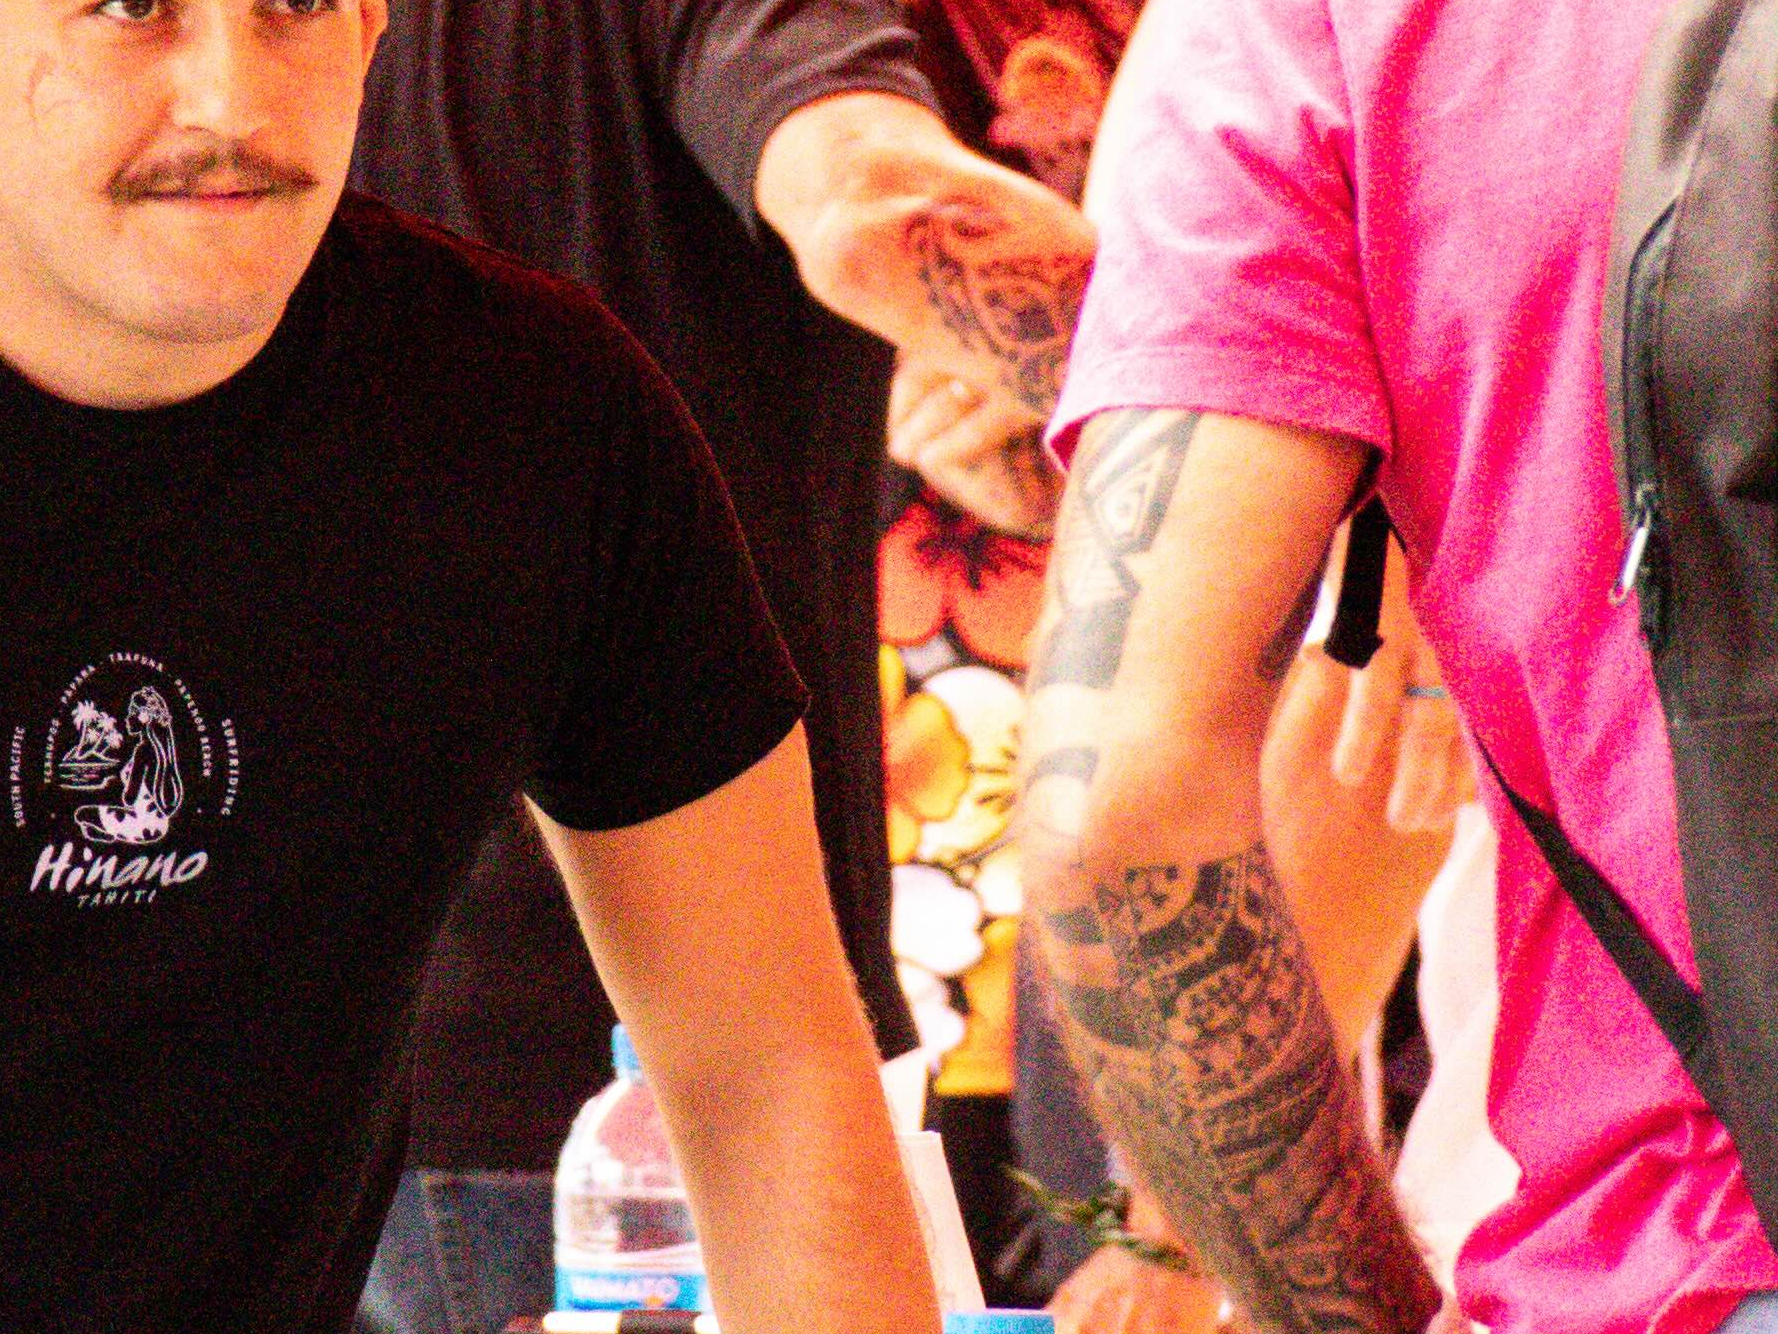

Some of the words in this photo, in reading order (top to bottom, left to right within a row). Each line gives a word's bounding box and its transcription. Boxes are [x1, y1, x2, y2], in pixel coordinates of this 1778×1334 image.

[9, 725, 26, 782] PACIFIC
[29, 841, 209, 893] Hinano
[77, 889, 158, 908] TAHITI
